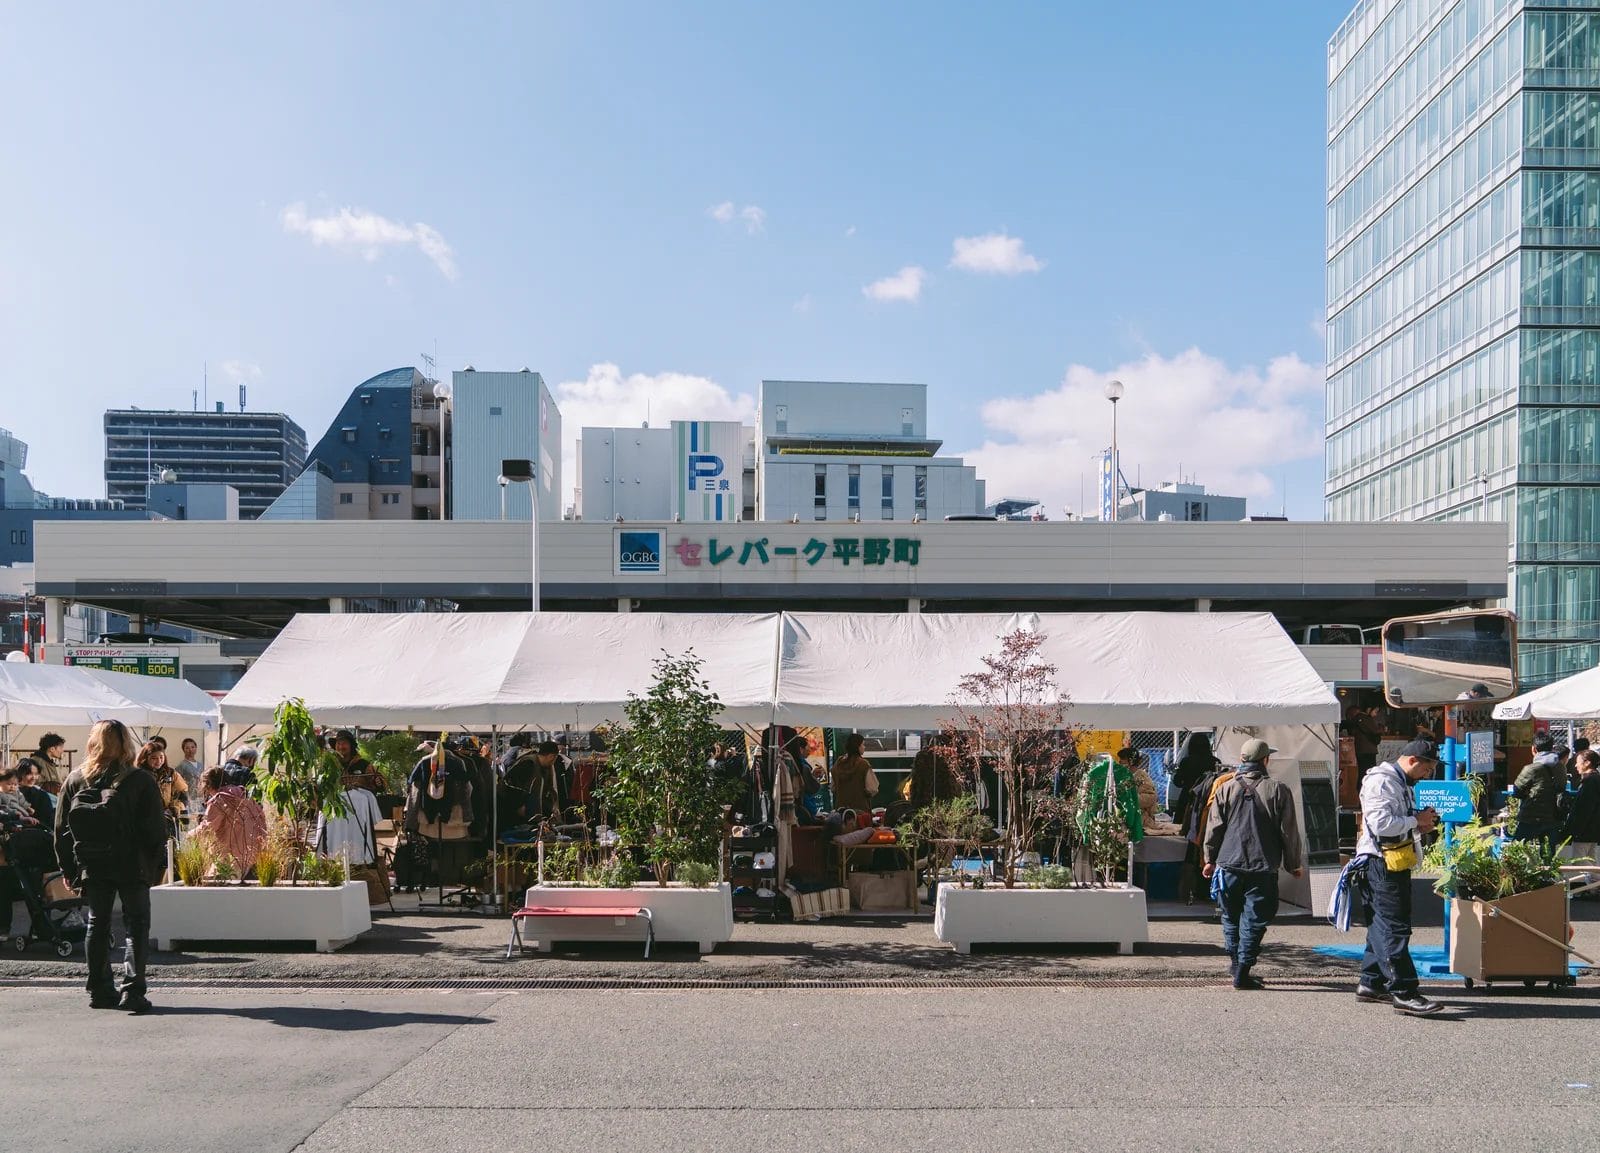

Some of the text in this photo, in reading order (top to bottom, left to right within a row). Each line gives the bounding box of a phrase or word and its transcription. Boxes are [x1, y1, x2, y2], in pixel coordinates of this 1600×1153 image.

[689, 455, 724, 491] P
[621, 551, 658, 562] OGBC
[674, 537, 921, 566] セレパーク平野町
[148, 665, 175, 674] 500円
